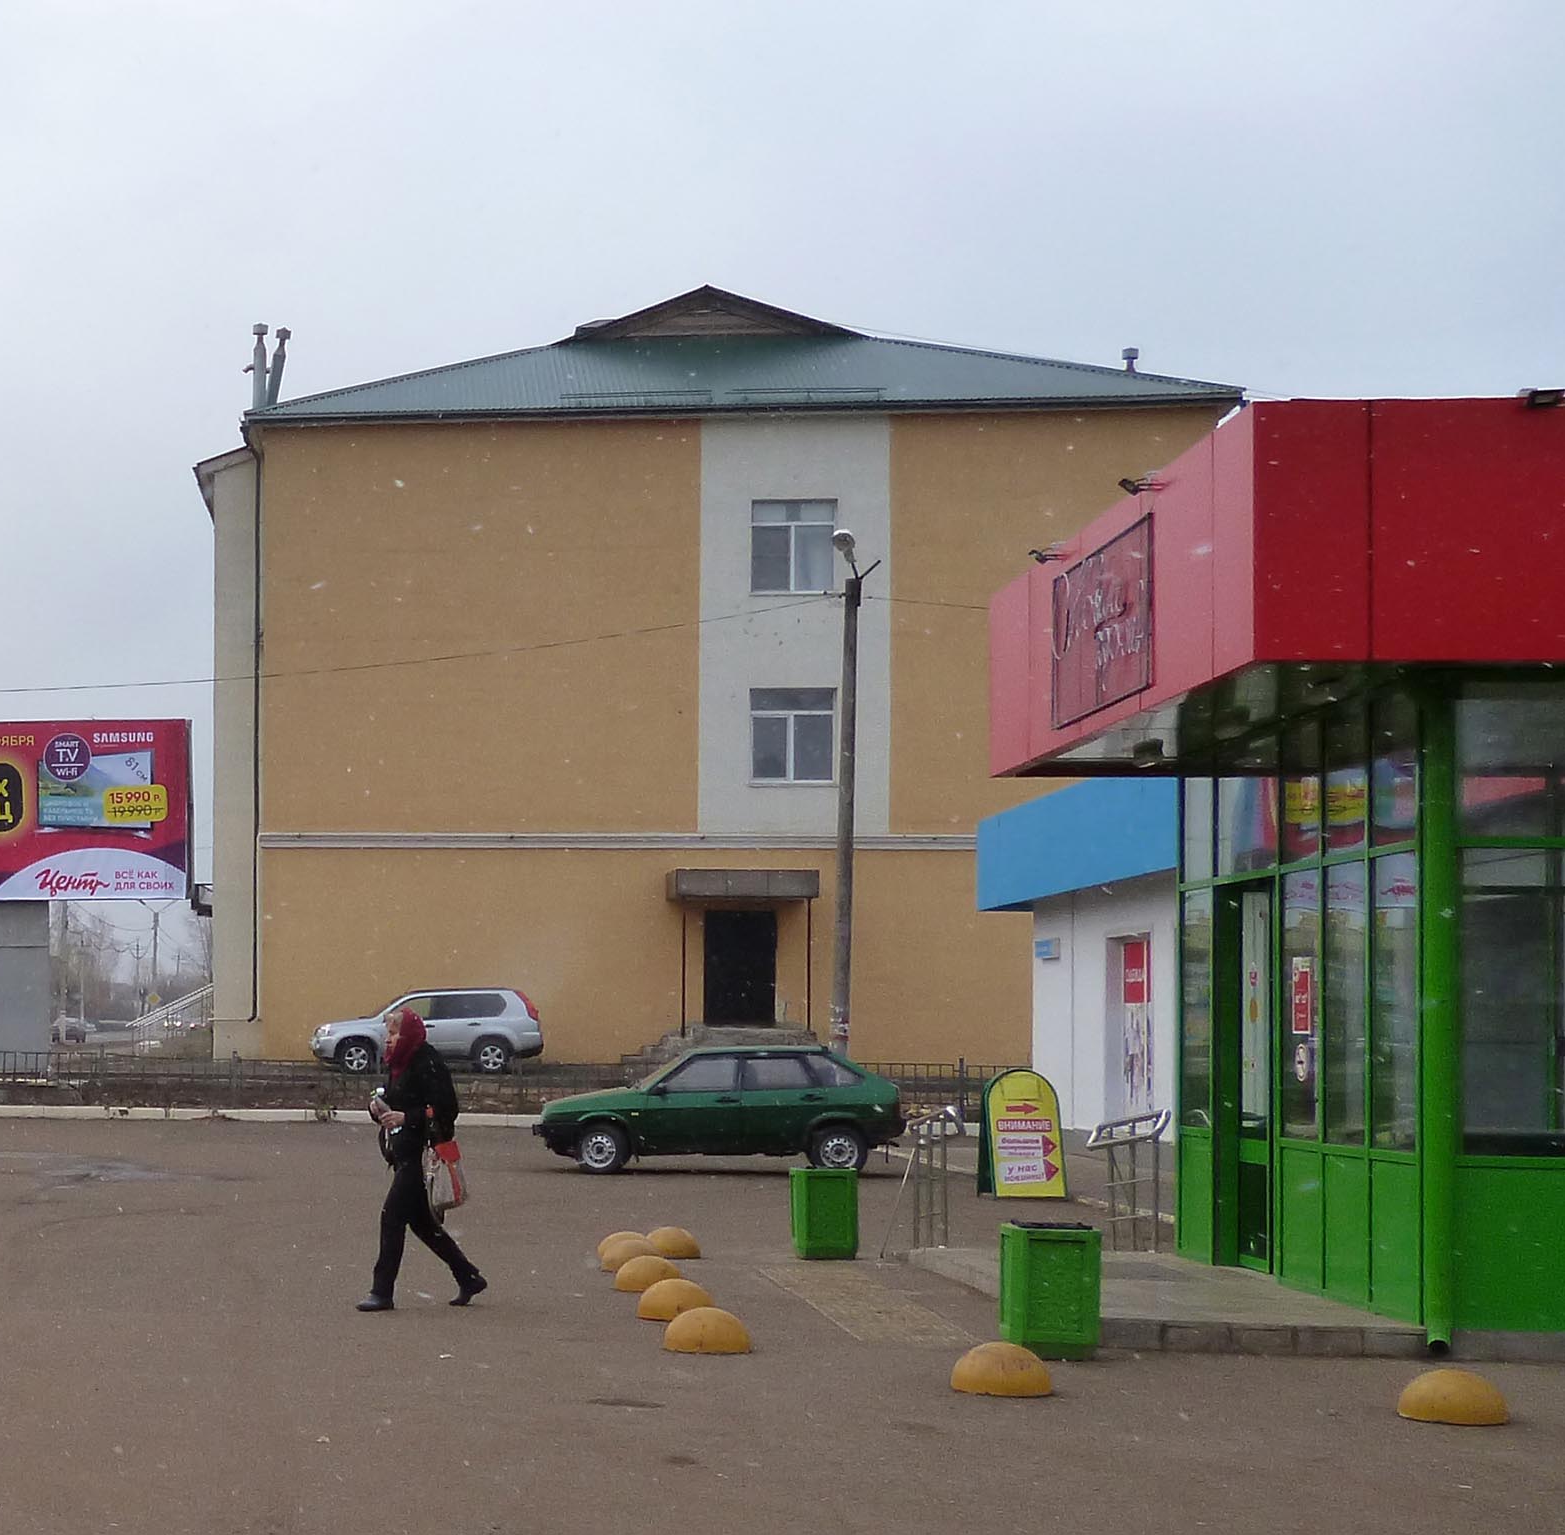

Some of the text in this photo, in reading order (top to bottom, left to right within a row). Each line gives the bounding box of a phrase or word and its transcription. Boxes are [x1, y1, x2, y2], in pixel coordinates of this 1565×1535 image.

[93, 732, 154, 743] SAMSUNG
[115, 869, 158, 880] ВСЁ КАК
[35, 868, 110, 897] Центр
[114, 880, 174, 891] ДЛЯ СВОИХ
[997, 1120, 1051, 1132] ВНИМАНИЕ
